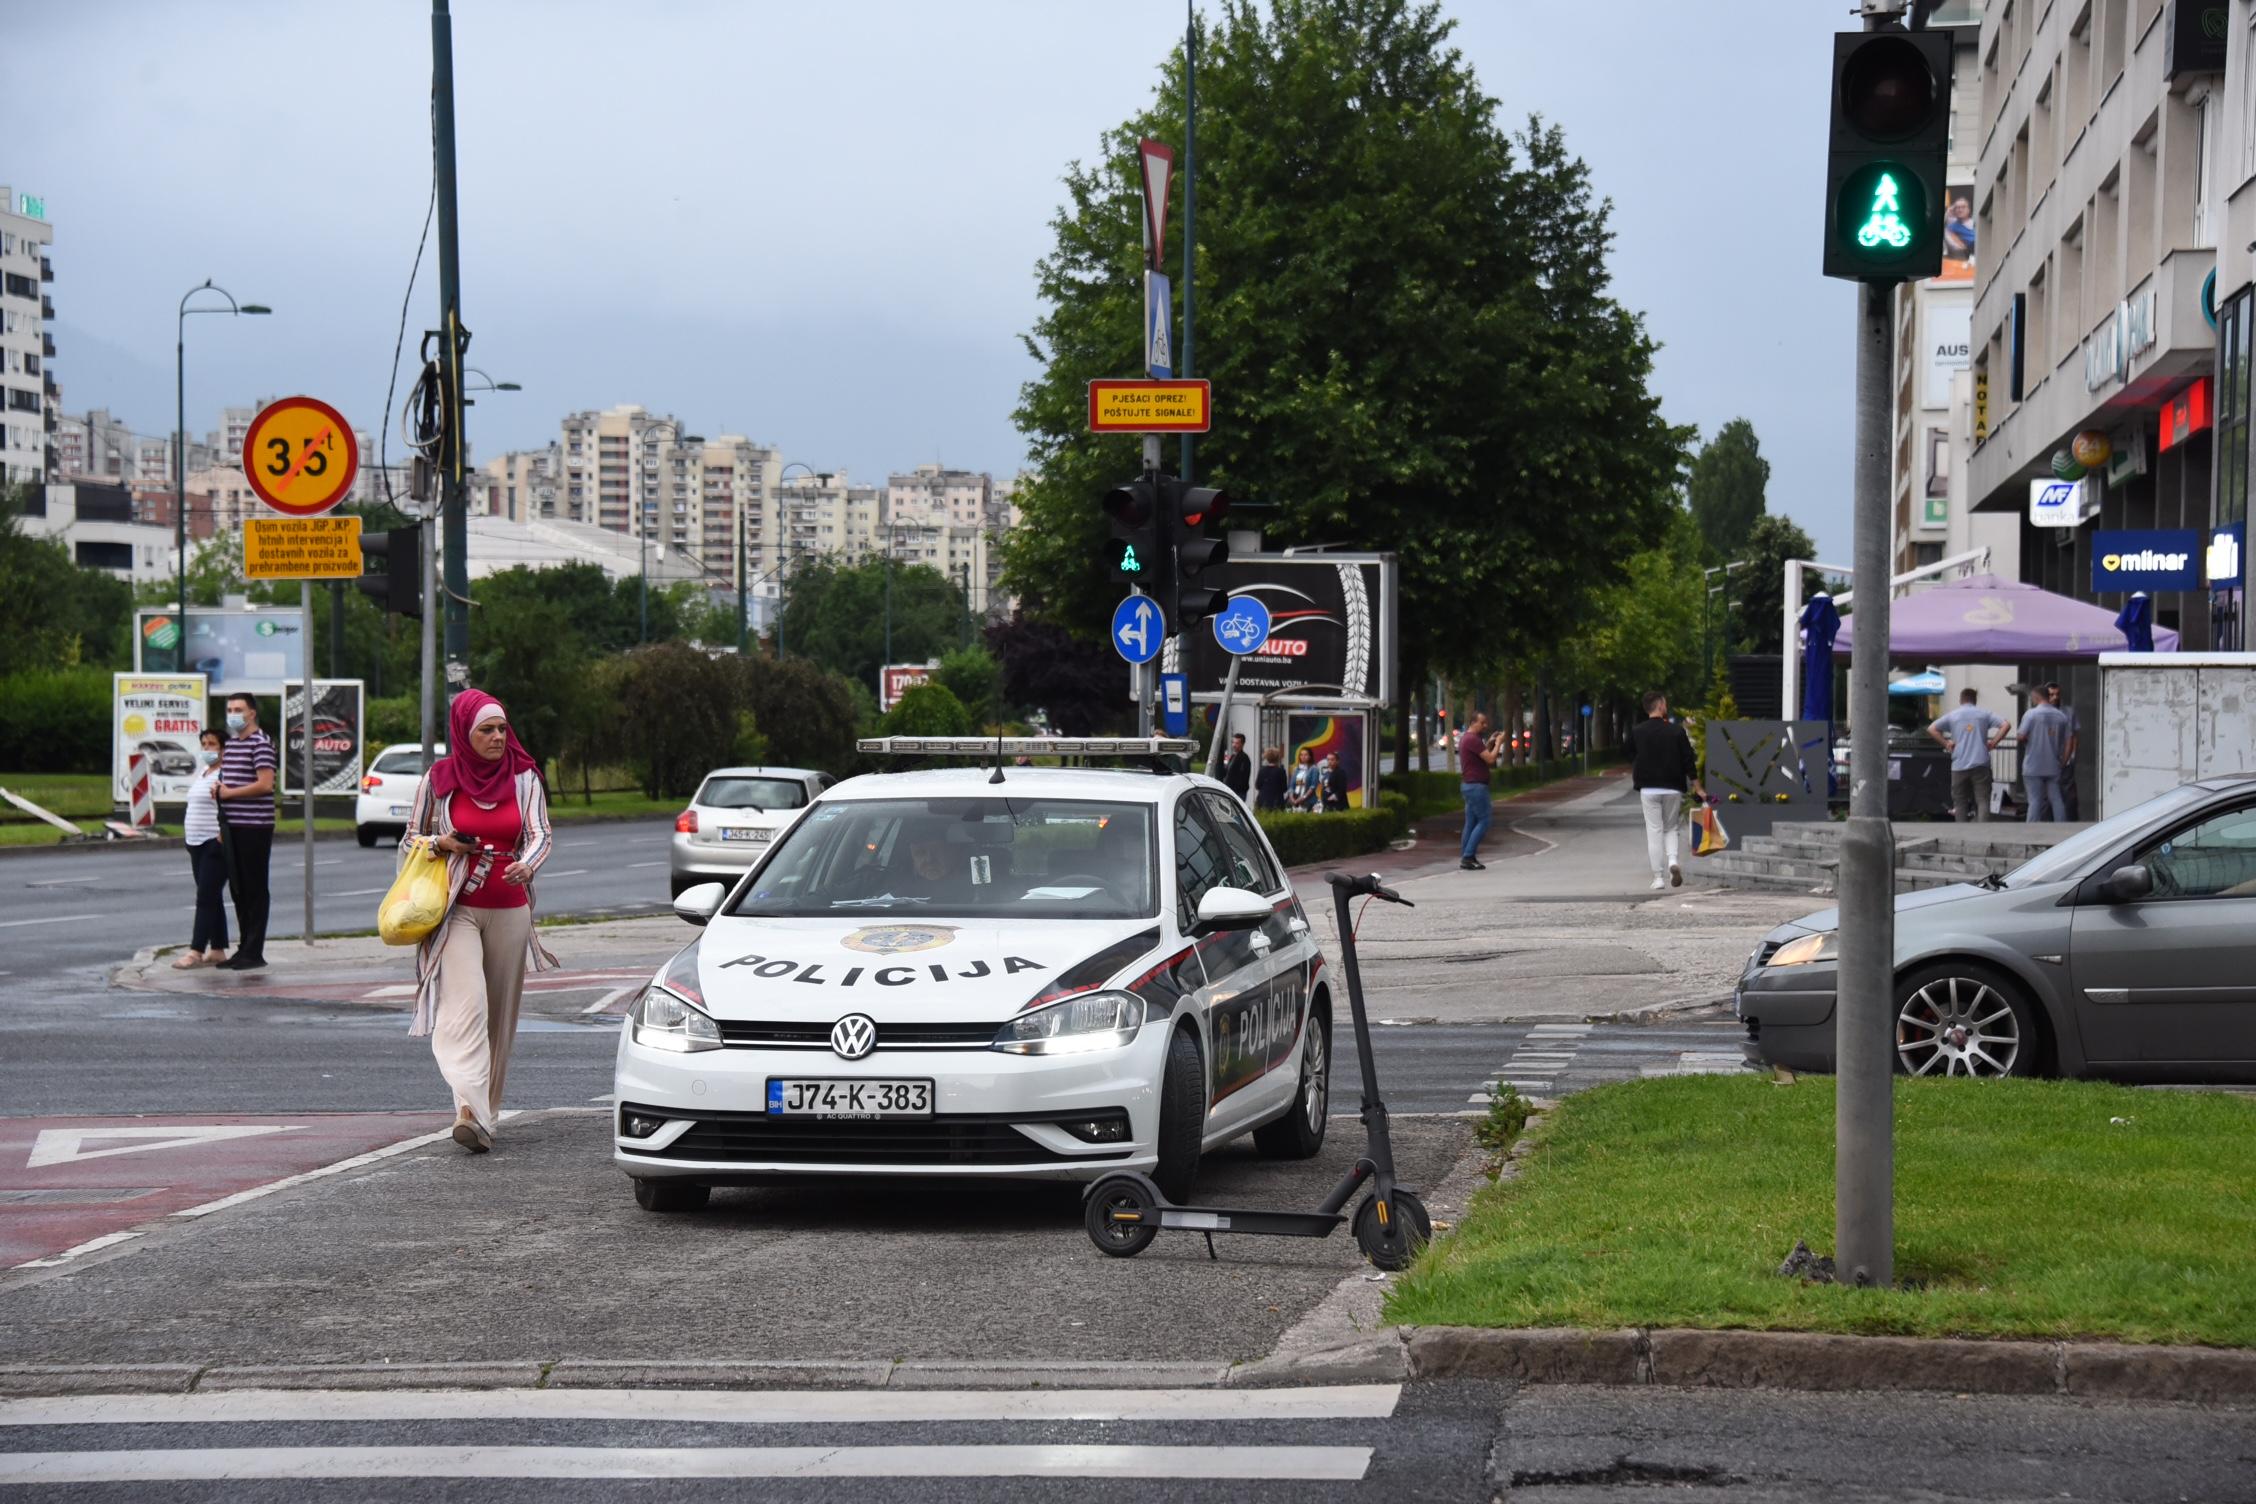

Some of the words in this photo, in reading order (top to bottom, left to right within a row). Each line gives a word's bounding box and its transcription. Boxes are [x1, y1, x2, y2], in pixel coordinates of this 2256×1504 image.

[1112, 394, 1151, 403] PJEŠACI
[1154, 394, 1187, 403] OPREZ!
[1104, 408, 1151, 417] POŠTUJTE
[1155, 408, 1196, 417] SIGNALE!
[255, 521, 278, 532] Osim
[281, 521, 308, 532] vozila
[259, 535, 283, 545] hitnih
[287, 535, 343, 548] intervencija
[259, 547, 305, 559] dostavnih
[308, 547, 335, 558] vozila
[338, 549, 349, 558] za
[249, 561, 310, 574] prehrambene
[313, 560, 358, 573] proizvode
[1258, 640, 1308, 655] AUTO
[1240, 679, 1280, 688] DOSTAVNA
[155, 720, 199, 733] GRATIS
[315, 738, 352, 751] AUTO
[718, 955, 1048, 986] POLICIJA
[1239, 984, 1297, 1061] POLICIJA
[788, 1084, 927, 1110] J74-K-383
